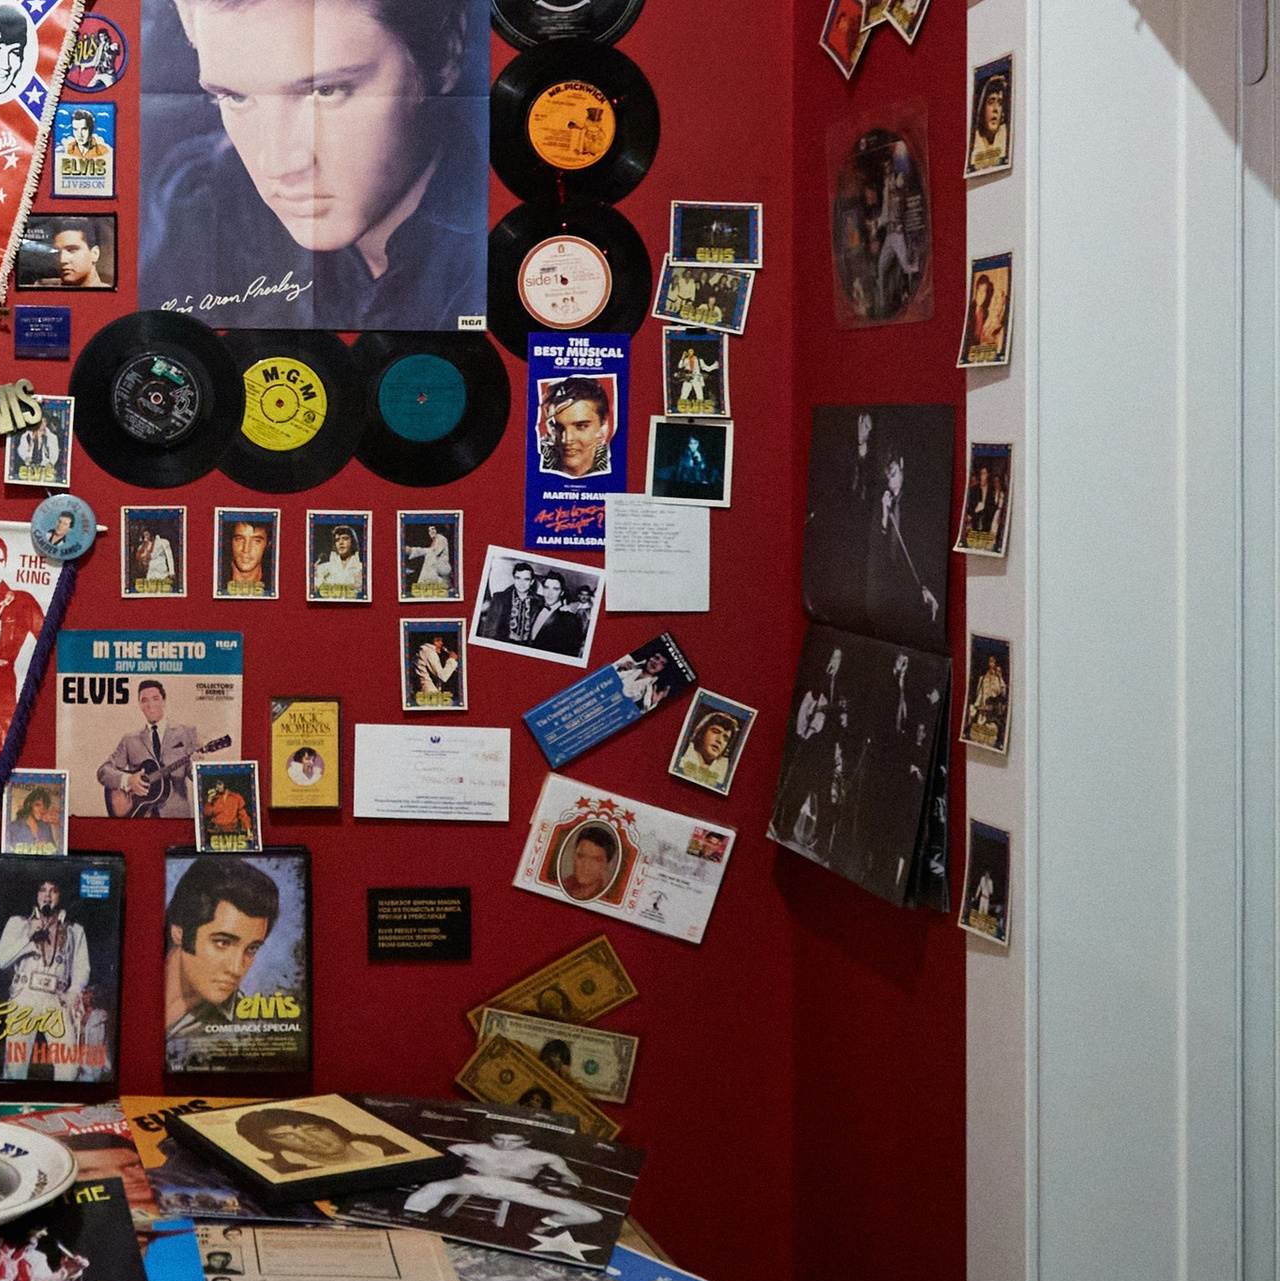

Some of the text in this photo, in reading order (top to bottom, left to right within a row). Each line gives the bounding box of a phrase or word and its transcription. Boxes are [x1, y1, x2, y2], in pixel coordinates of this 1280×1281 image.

[564, 82, 607, 105] PICKWICK
[61, 158, 107, 177] ELVIS
[525, 275, 551, 287] side
[461, 319, 483, 327] RCA
[568, 337, 590, 347] THE
[533, 346, 624, 358] BEST MUSICAL
[554, 357, 602, 367] OF 1985
[543, 491, 580, 500] MARTIN
[536, 536, 606, 546] ALAN BLEASDA
[20, 555, 46, 570] THE
[16, 569, 51, 586] KING
[93, 640, 207, 660] IN THE GHETTO
[667, 645, 683, 670] ELVIS
[62, 677, 130, 705] ELVIS
[288, 712, 323, 723] MAGIC
[280, 723, 331, 734] MOMENTS
[236, 991, 301, 1019] elvis
[205, 1023, 302, 1033] COMEBACK SPECIAL
[7, 1042, 27, 1065] IN
